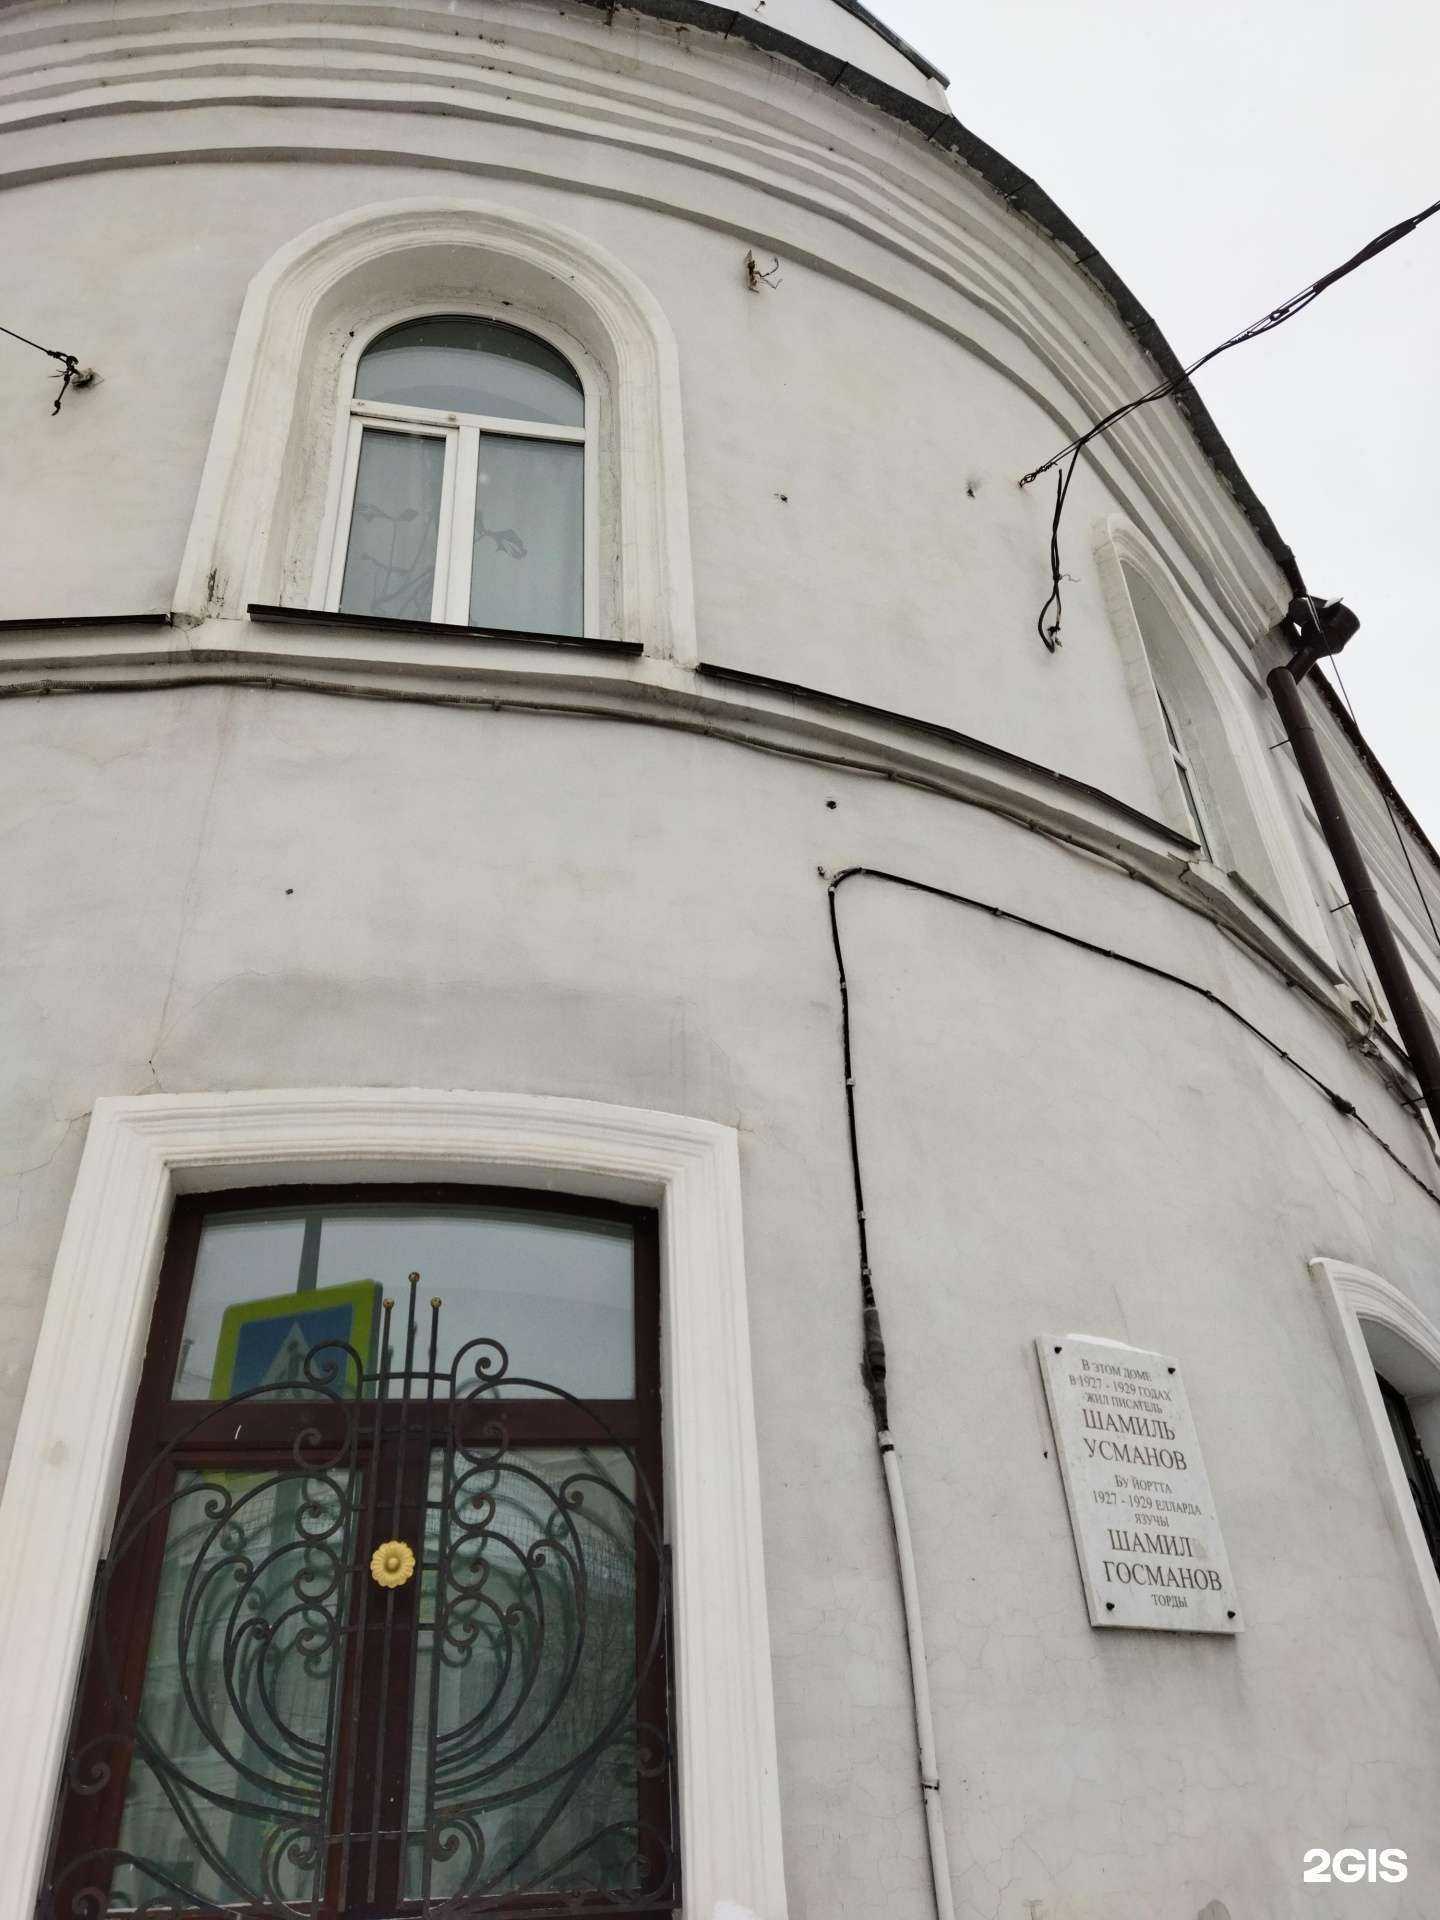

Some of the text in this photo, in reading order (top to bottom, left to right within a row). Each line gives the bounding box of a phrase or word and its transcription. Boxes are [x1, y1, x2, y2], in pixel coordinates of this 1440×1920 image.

[1081, 1359, 1090, 1371] В
[1092, 1362, 1121, 1376] ЭТОМ
[1069, 1375, 1077, 1386] В
[1079, 1375, 1102, 1390] 1927
[1113, 1381, 1136, 1395] 1929
[1138, 1386, 1173, 1401] ГОДАХ
[1086, 1392, 1163, 1414] ЖИЛ ПИСАТЕЛЬ
[1082, 1408, 1176, 1441] ШАМИЛЬ
[1083, 1438, 1188, 1471] УСМАНОВ
[1092, 1490, 1117, 1505] 1927
[1128, 1494, 1153, 1510] 1929
[1134, 1513, 1170, 1528] ЯЗУЧЫ
[1107, 1528, 1194, 1558] ШАМИЛ
[1102, 1560, 1223, 1592] ГОСМАНОВ
[1151, 1594, 1189, 1609] ТОРДЫ
